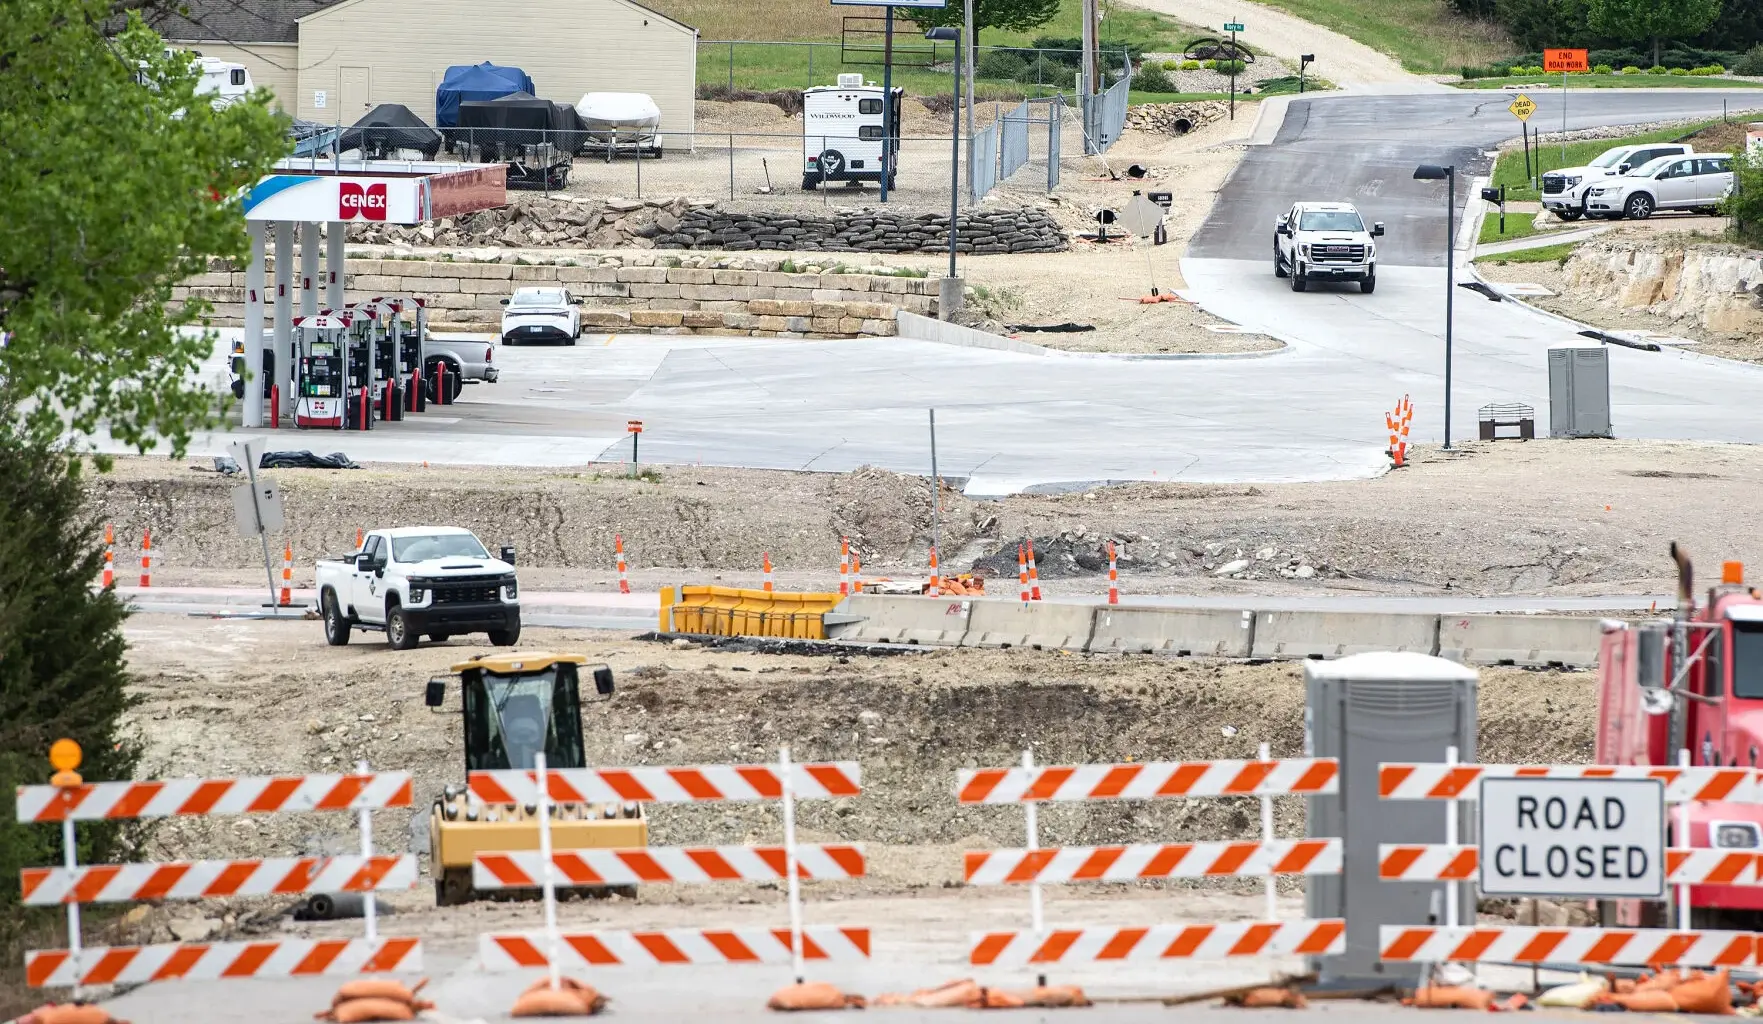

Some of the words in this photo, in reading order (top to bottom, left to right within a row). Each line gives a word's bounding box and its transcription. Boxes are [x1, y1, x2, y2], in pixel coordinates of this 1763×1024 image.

[1558, 52, 1573, 60] END
[1548, 61, 1565, 69] ROAD
[1514, 100, 1531, 108] DEAD
[1517, 108, 1530, 116] END
[341, 193, 385, 208] CENEX
[1517, 796, 1626, 830] ROAD
[1495, 844, 1649, 879] CLOSED
